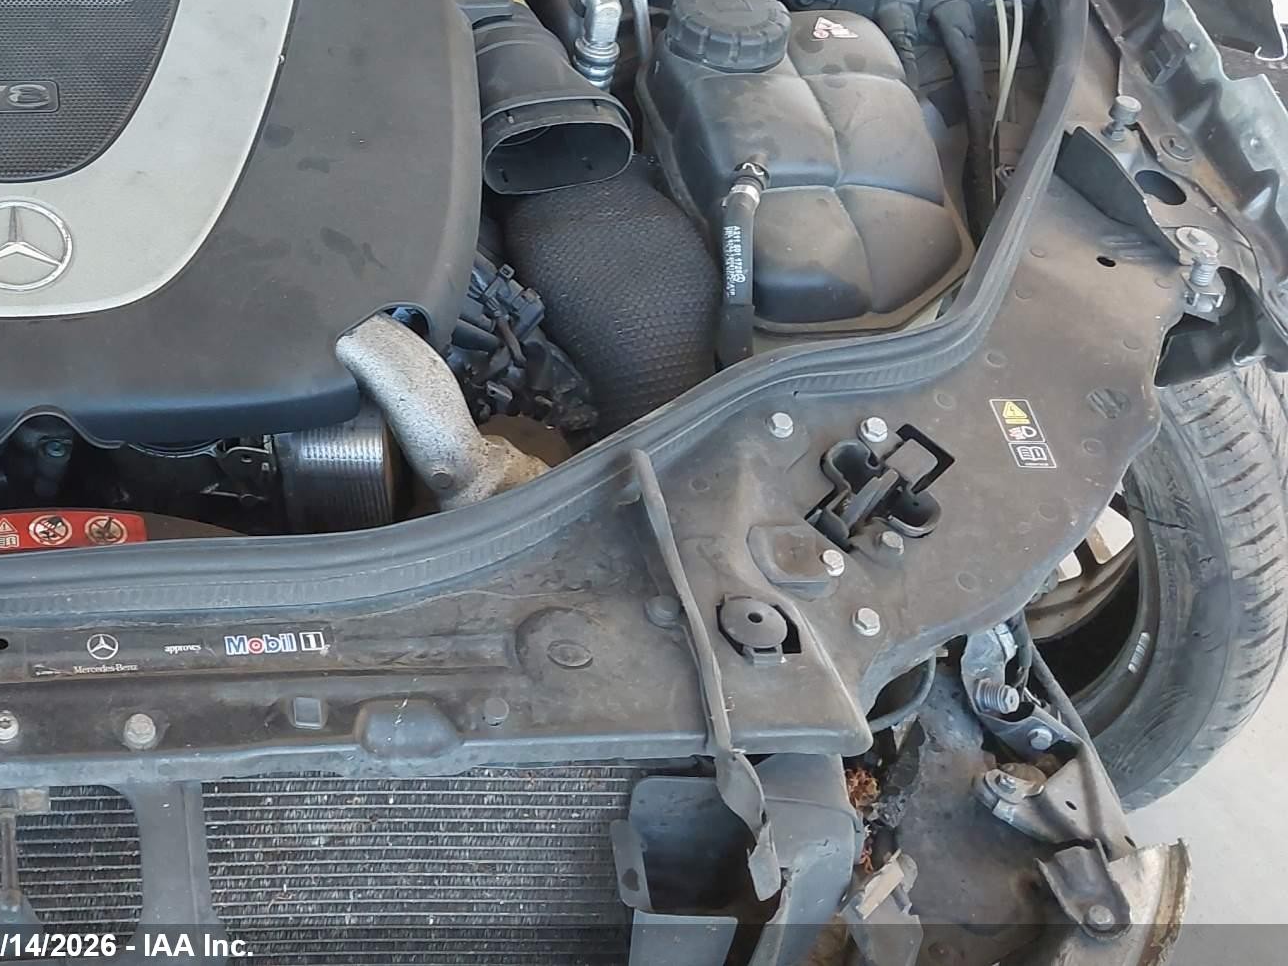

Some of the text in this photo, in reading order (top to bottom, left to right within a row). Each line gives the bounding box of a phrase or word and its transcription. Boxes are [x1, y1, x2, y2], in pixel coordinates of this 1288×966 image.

[164, 644, 202, 655] approves
[224, 633, 297, 656] Mobil
[73, 663, 139, 675] Mercedes-Benz
